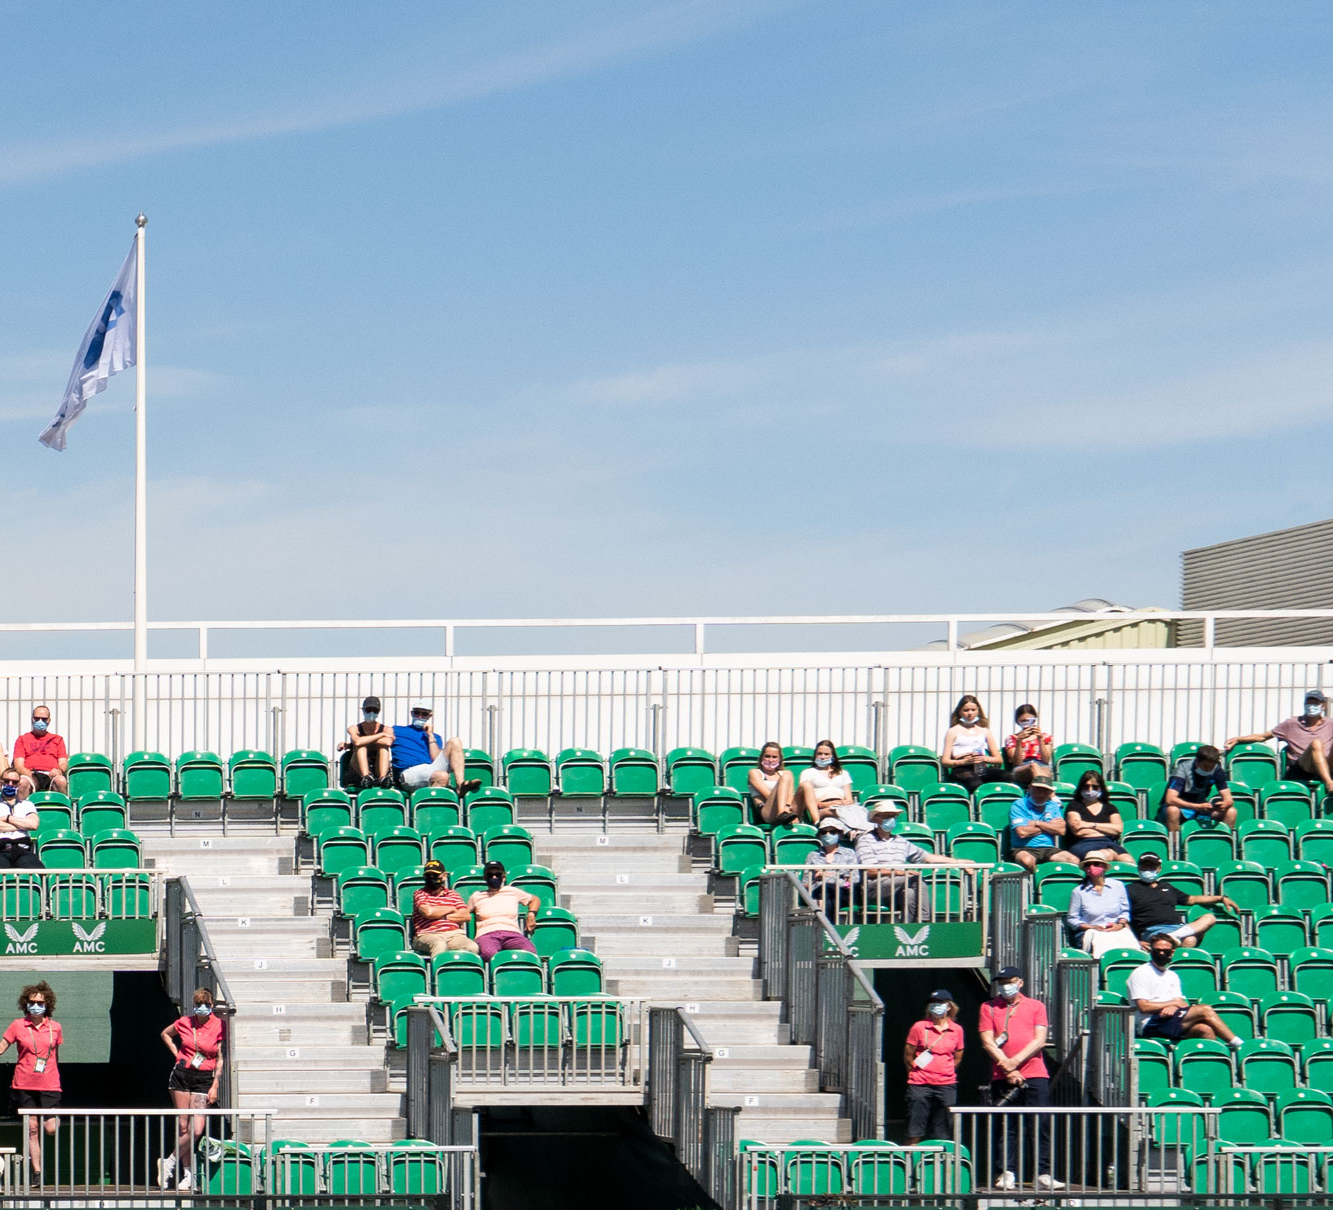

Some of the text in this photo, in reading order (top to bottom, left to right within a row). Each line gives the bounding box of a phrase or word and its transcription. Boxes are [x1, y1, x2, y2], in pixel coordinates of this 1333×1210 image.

[5, 943, 37, 954] AMC
[73, 941, 105, 952] AMC
[895, 945, 929, 956] AMC
